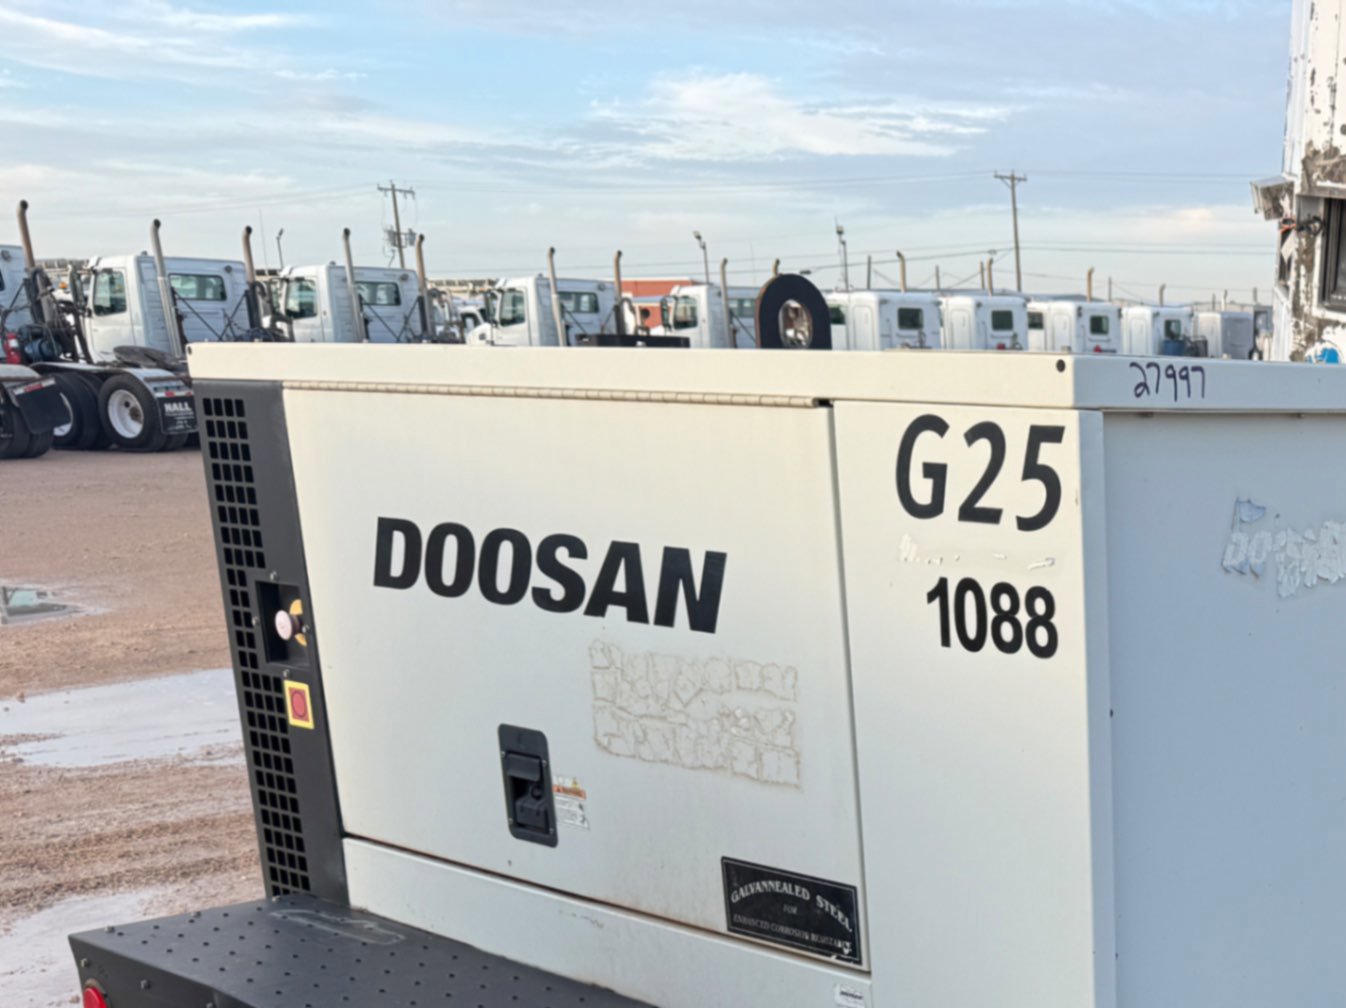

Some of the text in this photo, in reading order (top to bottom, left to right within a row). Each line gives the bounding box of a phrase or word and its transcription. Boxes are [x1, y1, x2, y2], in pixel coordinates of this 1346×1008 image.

[1129, 362, 1205, 402] 27997
[896, 414, 1065, 532] G25
[373, 516, 727, 634] DOOSAN
[927, 576, 1058, 659] 1088
[731, 880, 853, 932] GALVANNEALED STEEL
